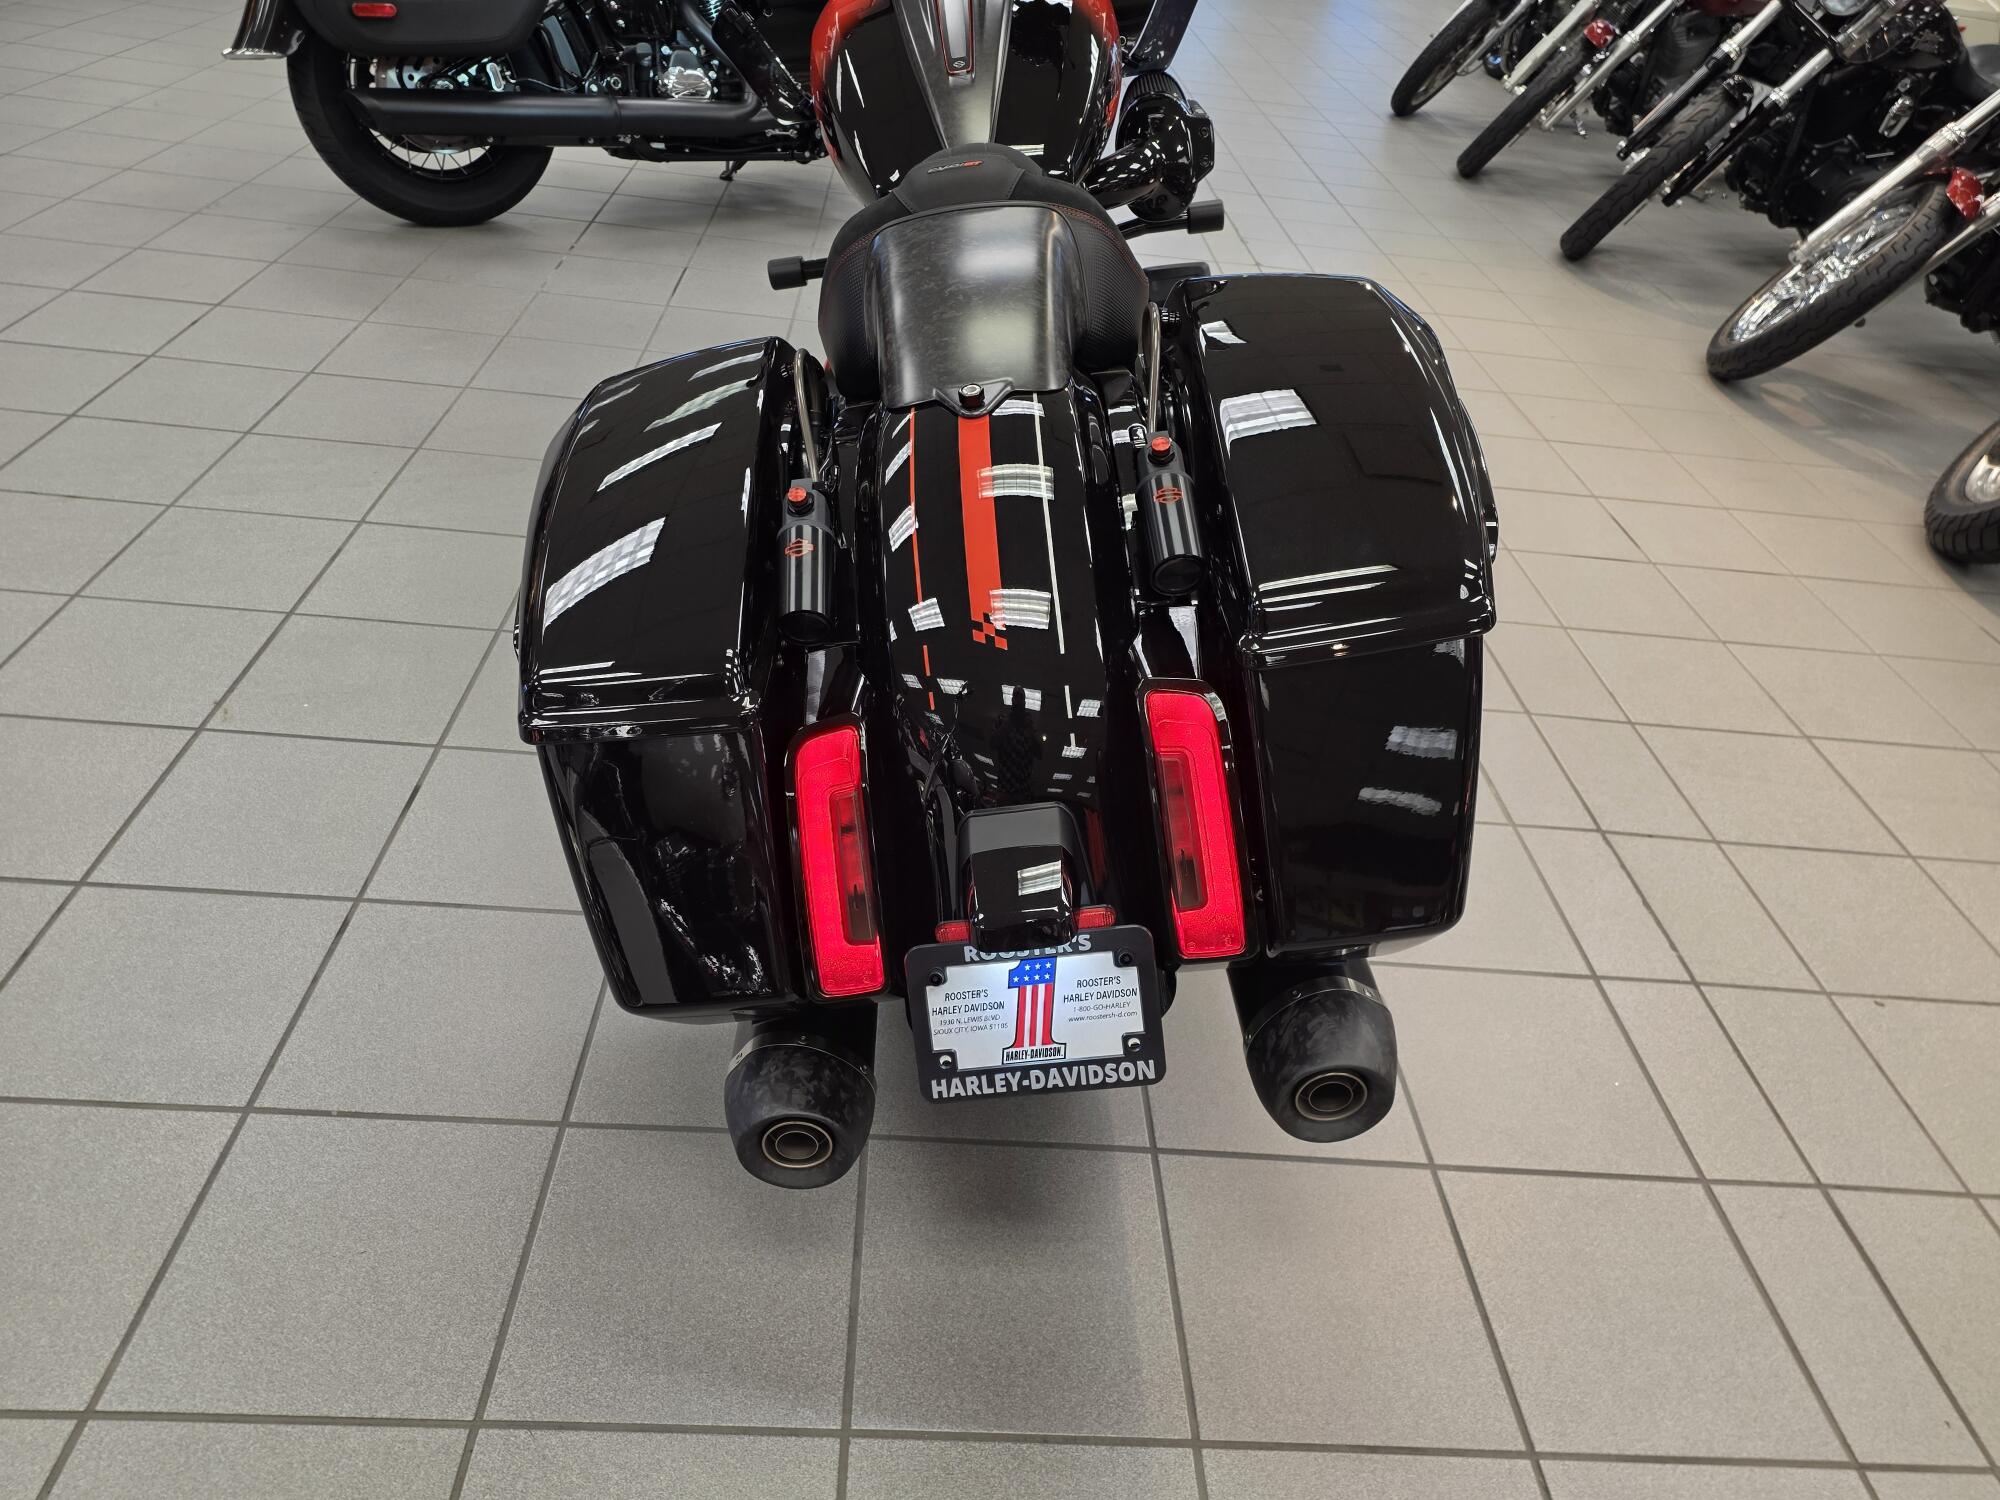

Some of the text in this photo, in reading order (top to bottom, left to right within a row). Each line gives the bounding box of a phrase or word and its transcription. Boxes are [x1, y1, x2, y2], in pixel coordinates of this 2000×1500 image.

[1077, 975, 1121, 988] ROOSTER'S
[945, 989, 989, 1002] ROOSTER'S
[1063, 987, 1138, 1003] HARLEY DAVIDSON
[932, 1001, 1005, 1016] HARLEY DAVIDSON
[933, 1028, 953, 1036] SIOUX
[970, 1024, 988, 1032] IOWA
[931, 1059, 1156, 1099] HARLEY-DAVIDSON
